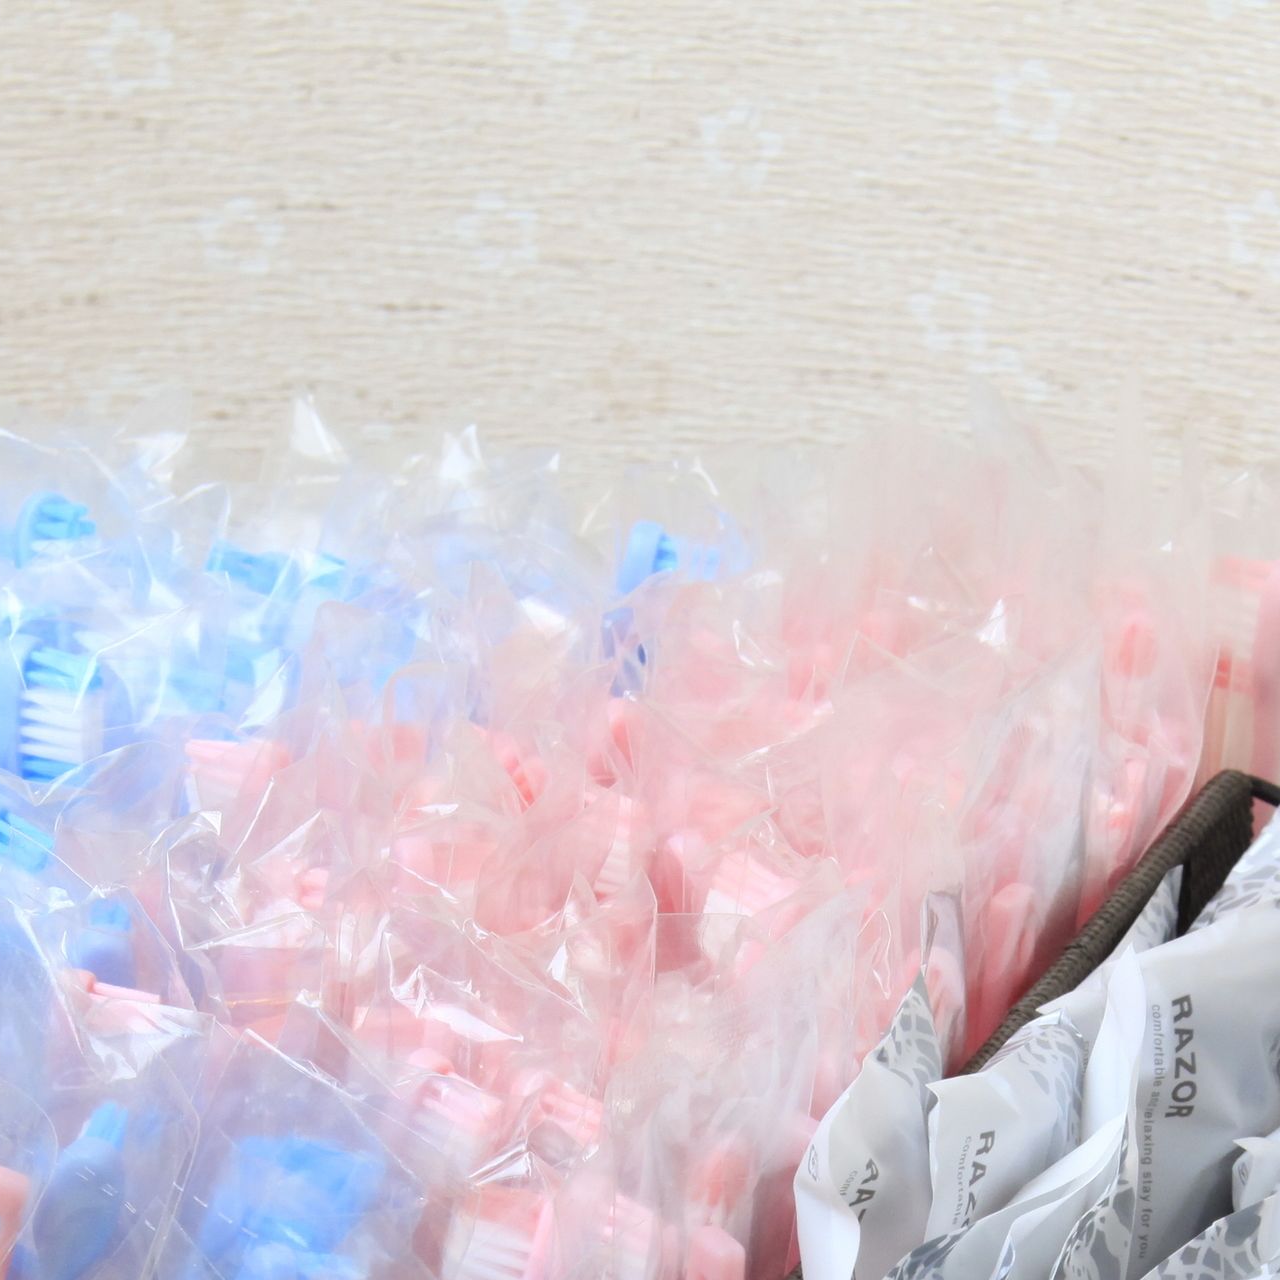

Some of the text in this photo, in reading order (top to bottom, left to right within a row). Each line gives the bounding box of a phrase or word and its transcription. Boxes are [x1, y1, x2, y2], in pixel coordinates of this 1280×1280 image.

[1151, 1004, 1165, 1087] comfortable
[1165, 994, 1197, 1118] RAZOR
[1140, 1171, 1153, 1201] stay
[1140, 1208, 1153, 1228] for
[1138, 1234, 1150, 1259] you
